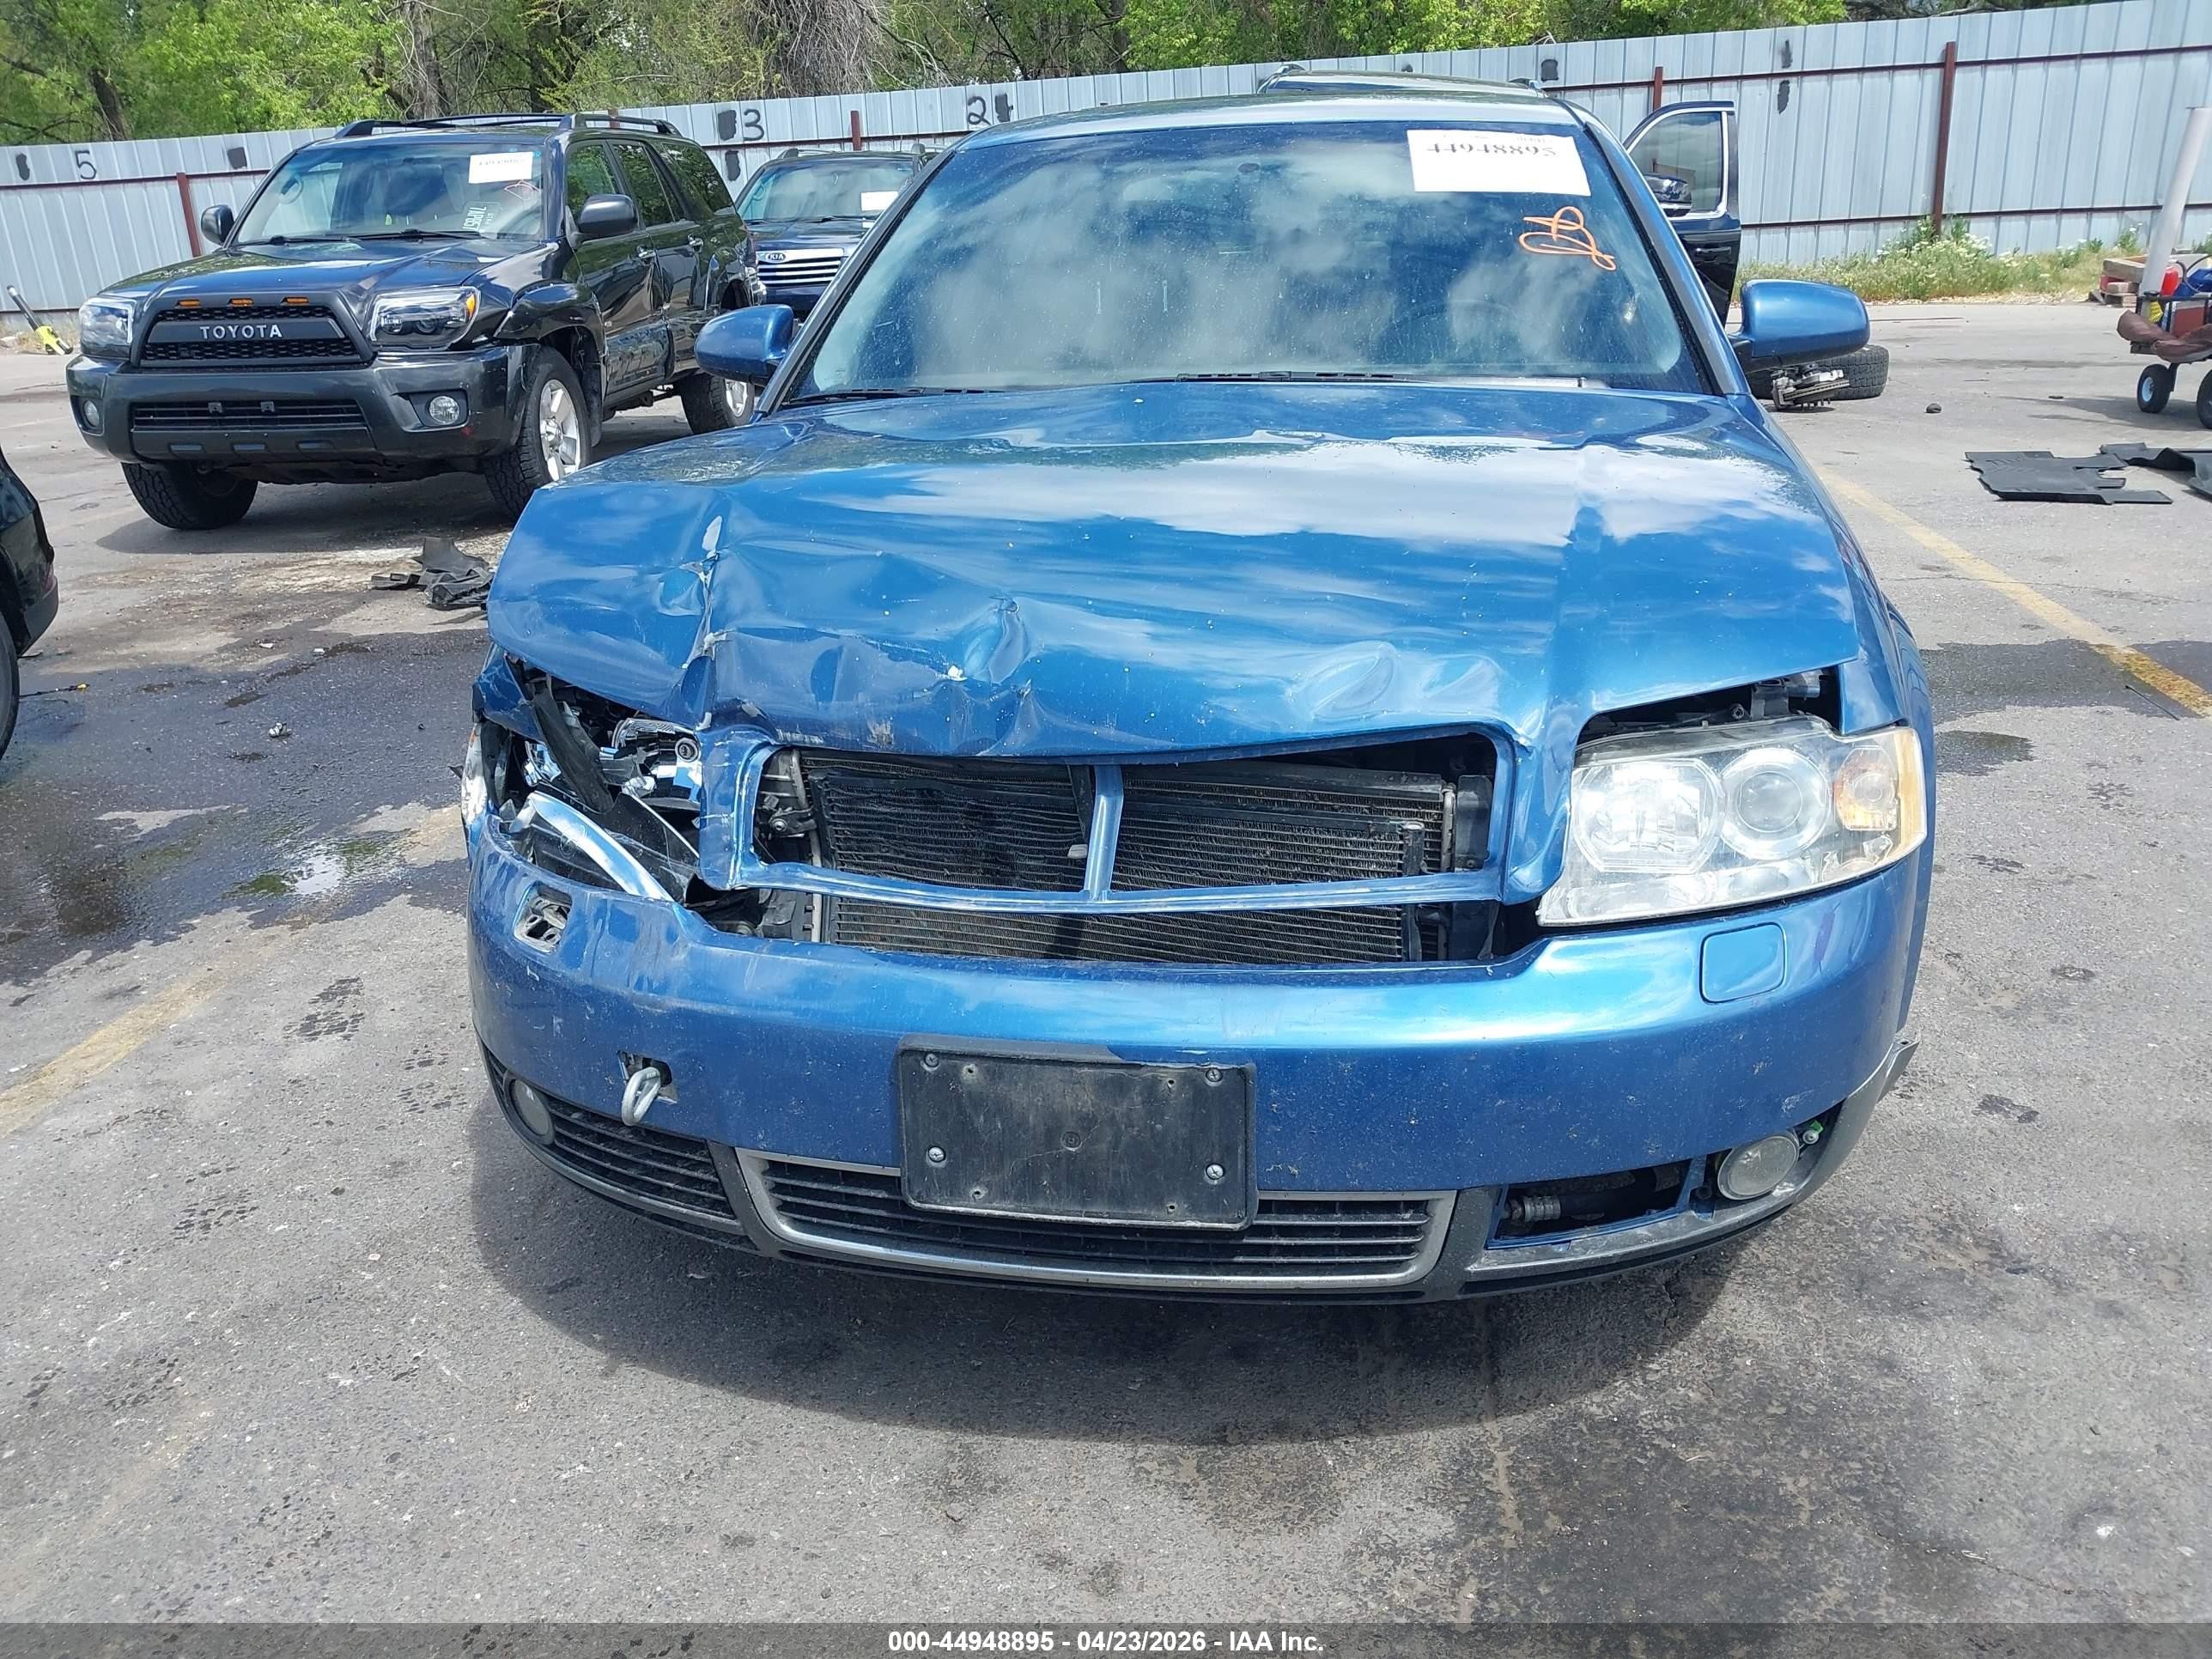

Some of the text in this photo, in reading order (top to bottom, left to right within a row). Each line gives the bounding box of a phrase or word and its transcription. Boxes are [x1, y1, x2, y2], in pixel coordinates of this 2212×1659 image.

[744, 108, 764, 141] 3
[968, 95, 992, 125] 2
[75, 149, 97, 179] 5
[199, 325, 283, 339] TOYOTA
